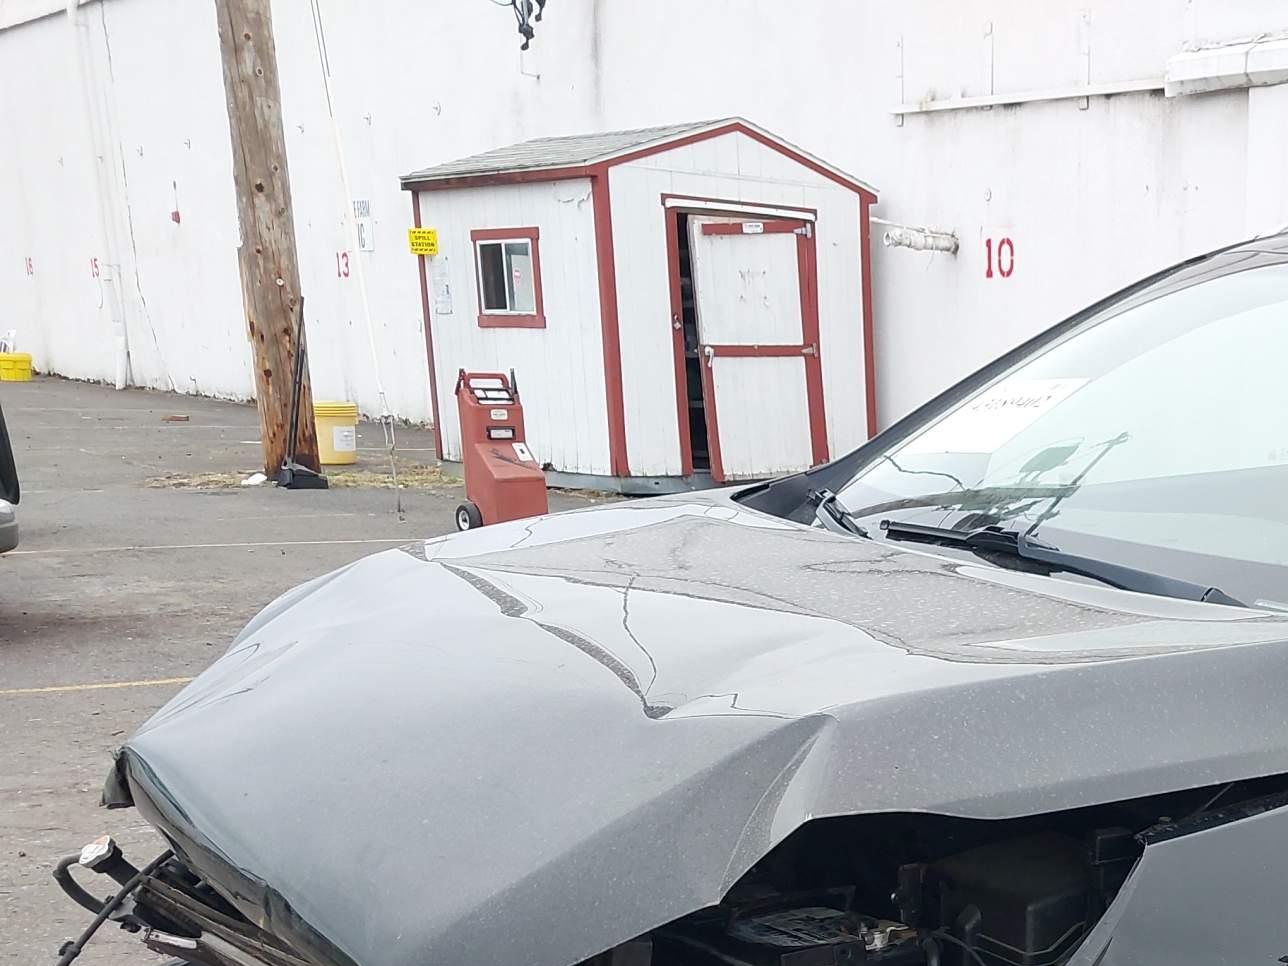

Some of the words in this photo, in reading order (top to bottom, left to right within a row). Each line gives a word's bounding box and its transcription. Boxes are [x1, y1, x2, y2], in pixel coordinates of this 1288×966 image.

[90, 257, 100, 278] 15
[336, 251, 350, 278] 13
[985, 237, 1014, 278] 10
